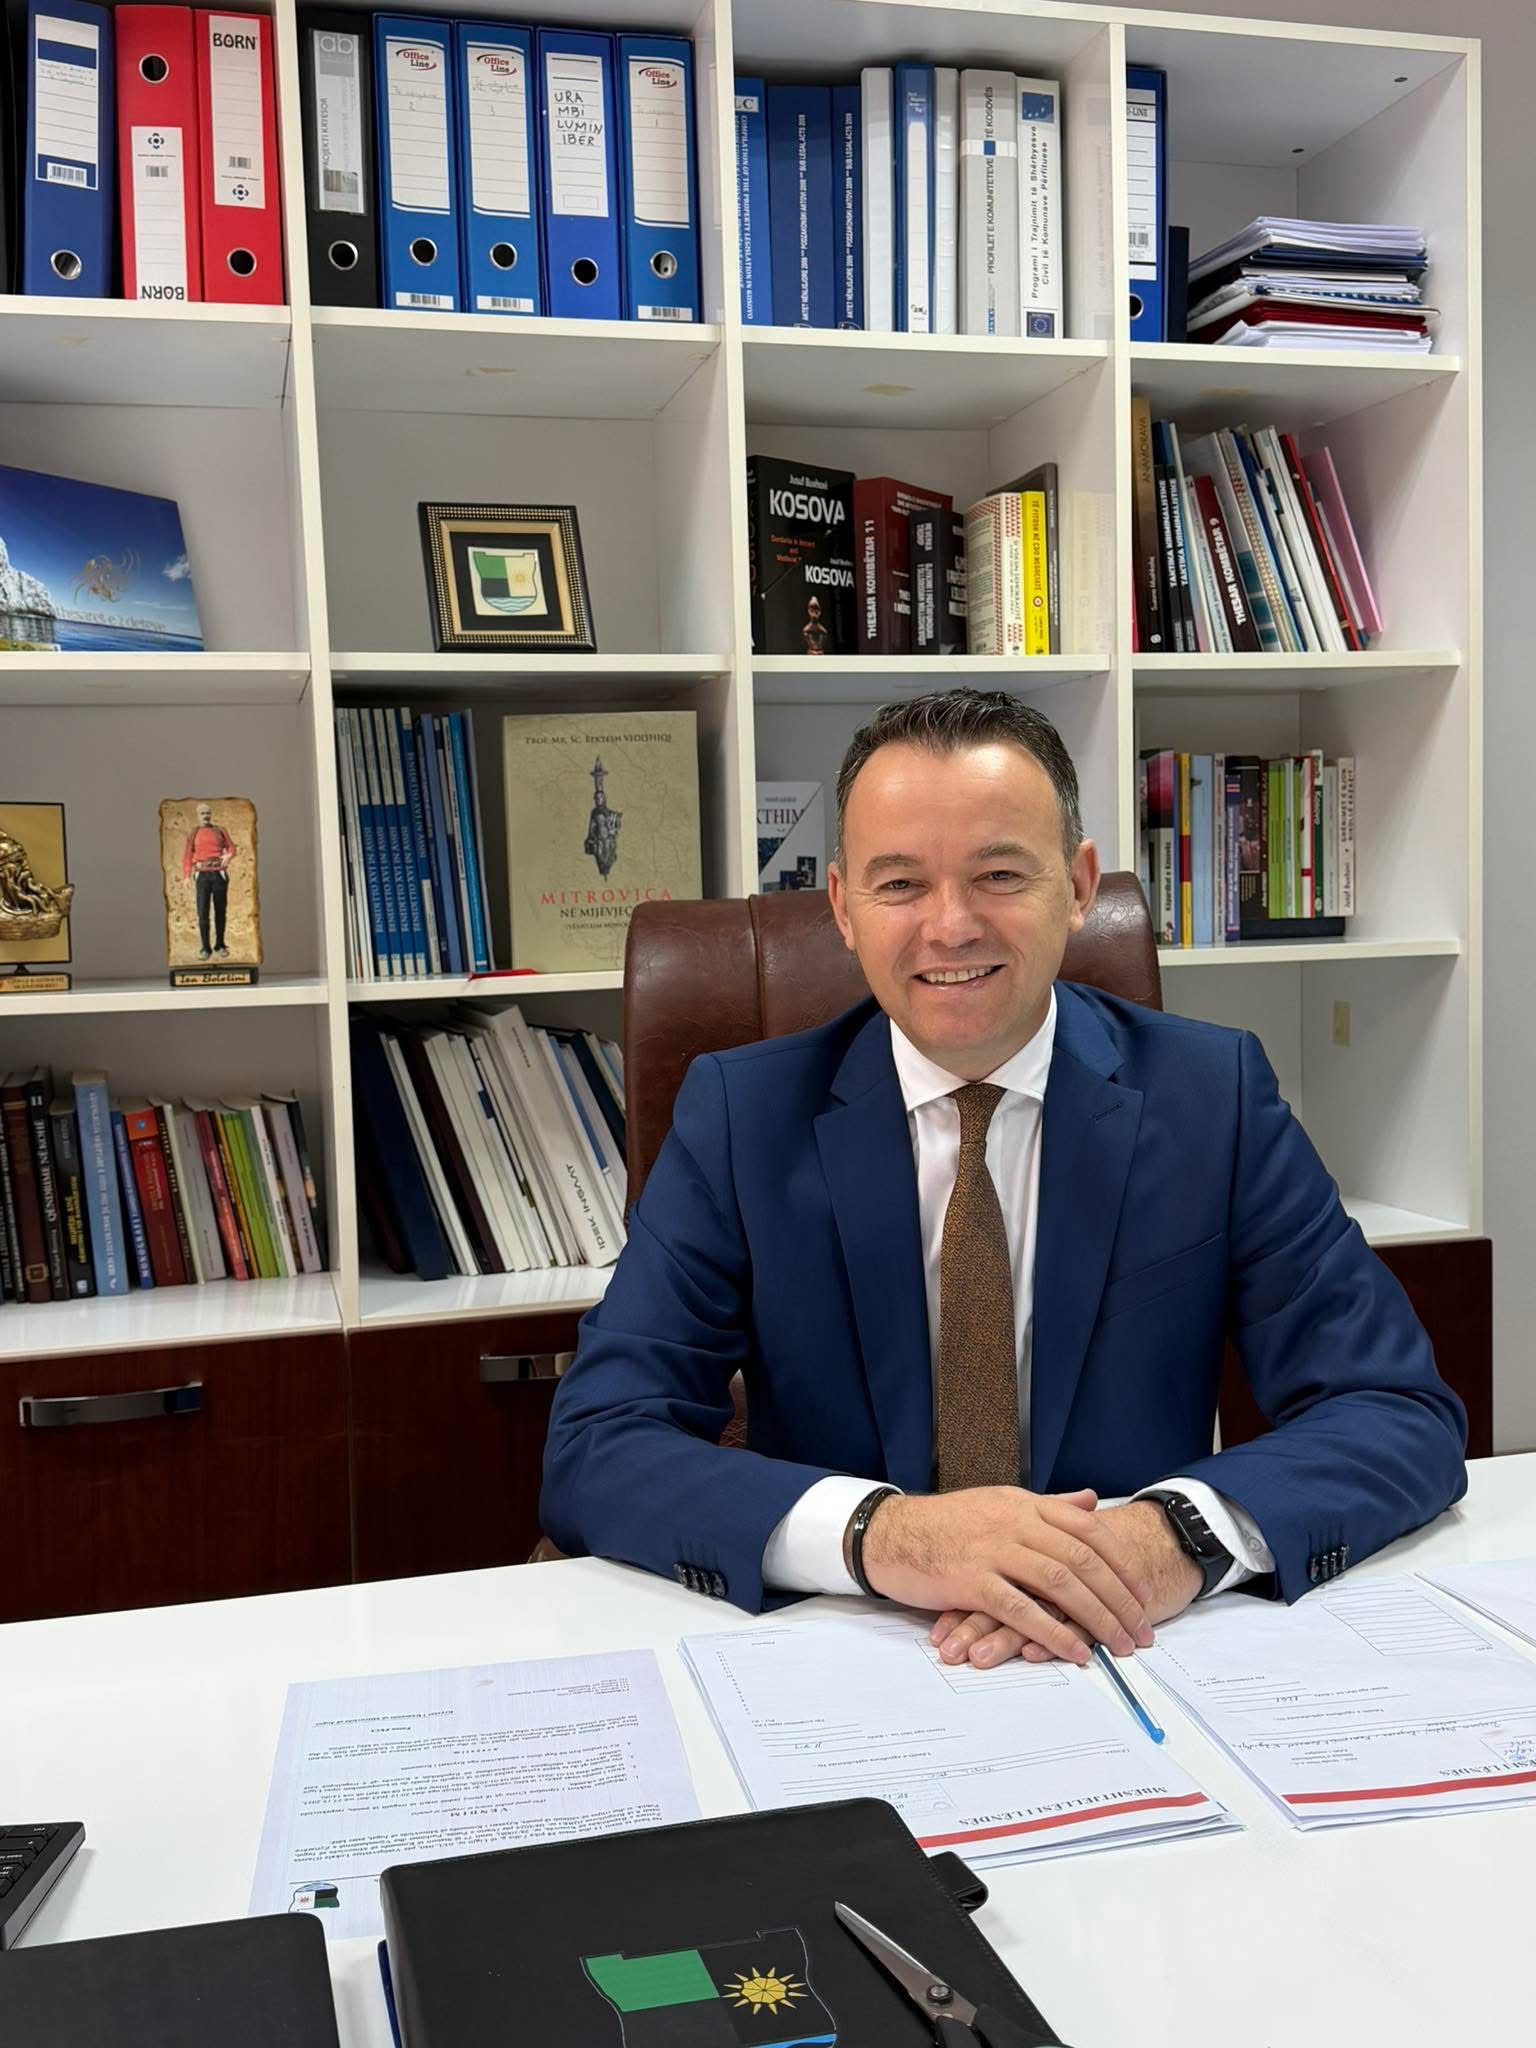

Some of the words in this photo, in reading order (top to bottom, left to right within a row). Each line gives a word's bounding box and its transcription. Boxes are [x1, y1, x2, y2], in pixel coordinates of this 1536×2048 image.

[213, 32, 256, 51] BORN
[403, 50, 428, 60] Office
[410, 60, 430, 68] Line
[484, 56, 510, 66] Office
[491, 65, 510, 73] Line
[645, 70, 670, 79] Office
[652, 78, 670, 86] Line
[554, 90, 584, 103] URA
[984, 86, 994, 127] KOSOVËS
[562, 133, 595, 146] IBER
[986, 158, 994, 225] KOMUNITETEVE
[1030, 200, 1039, 242] Trajnimit
[1040, 195, 1049, 244] Komunave
[987, 234, 995, 274] PROFILET
[1030, 256, 1040, 299] Programi
[1041, 263, 1050, 285] Civil
[141, 285, 185, 301] BORN
[769, 488, 846, 525] KOSOVA
[1210, 517, 1219, 526] 9
[864, 536, 876, 594] KOMBËTAR
[1214, 528, 1235, 587] KOMBËTAR
[804, 564, 855, 588] KOSOVA
[1226, 581, 1247, 626] THESAR
[866, 596, 877, 639] THESAR
[369, 866, 378, 883] XVI
[381, 865, 390, 883] XVI
[394, 865, 403, 882] XVI
[406, 865, 415, 882] XVI
[540, 886, 673, 906] MITROVICA
[586, 1215, 606, 1250] IPEK
